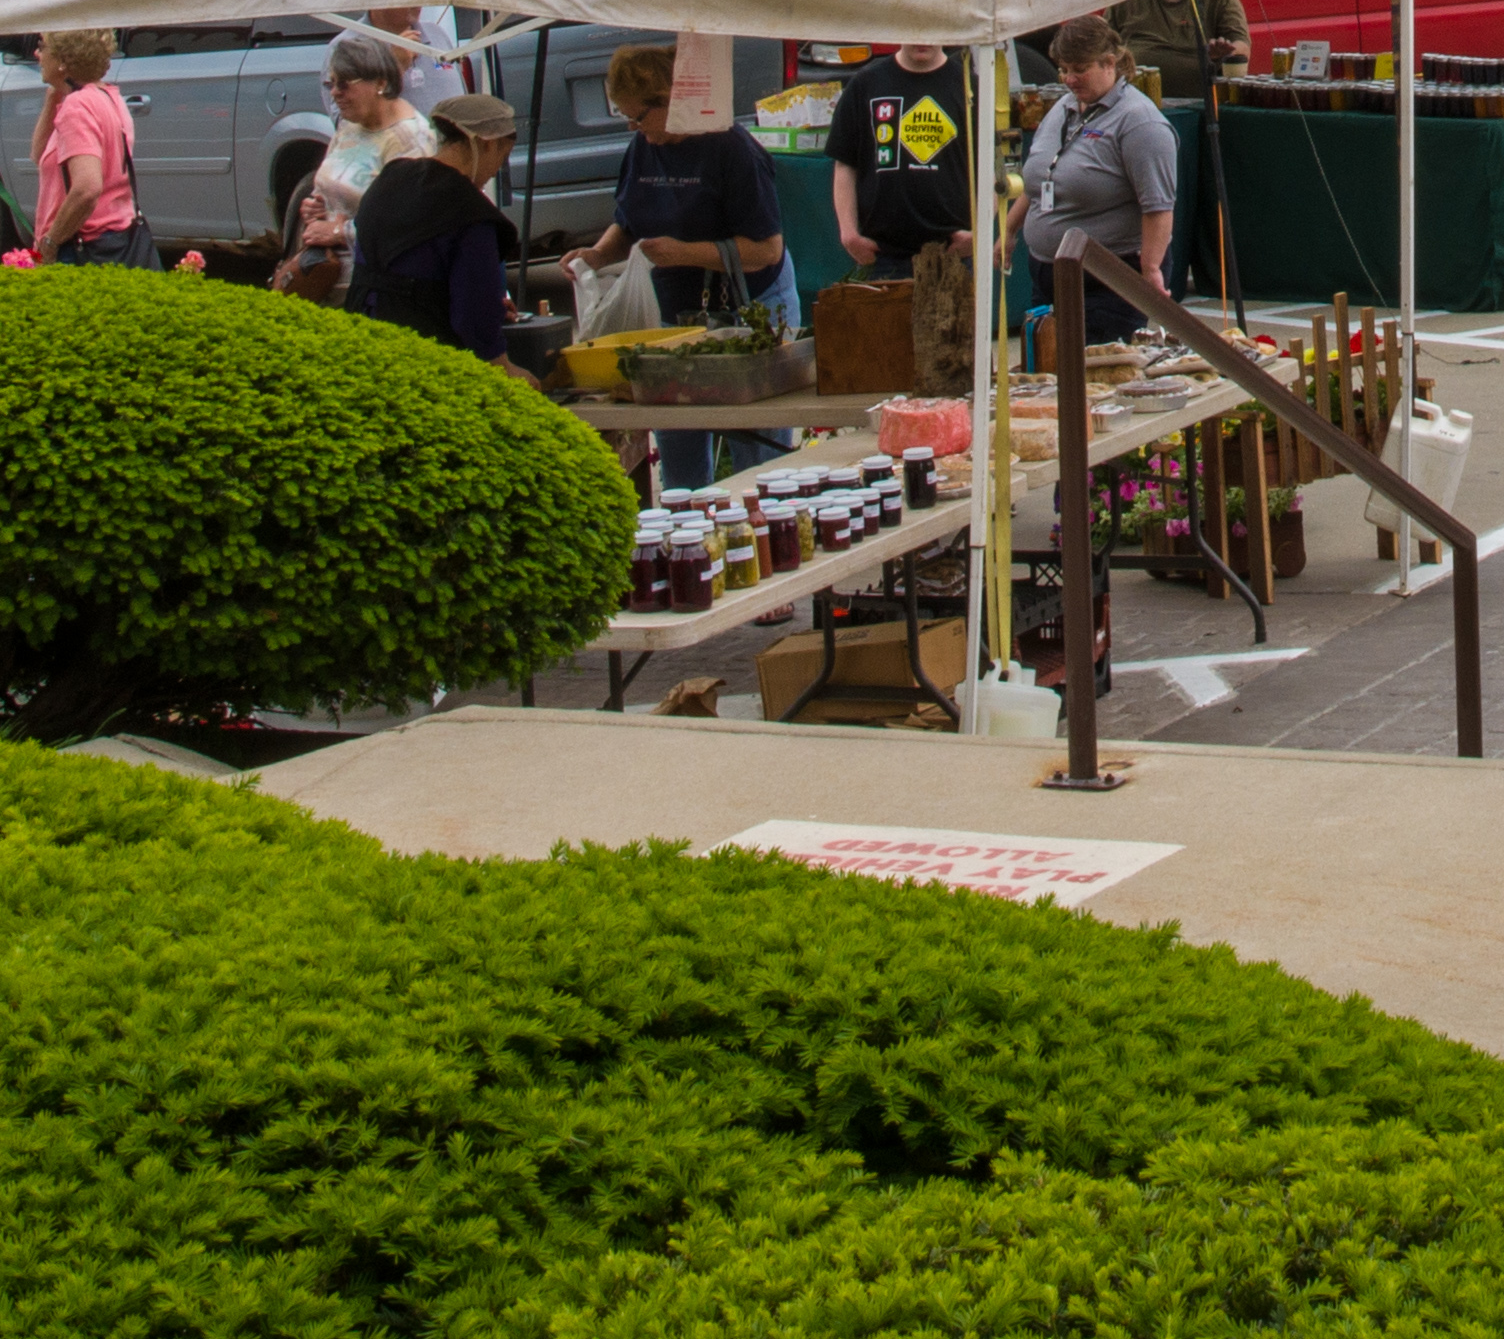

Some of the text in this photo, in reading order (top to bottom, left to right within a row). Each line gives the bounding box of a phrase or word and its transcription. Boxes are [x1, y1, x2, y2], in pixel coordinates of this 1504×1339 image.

[878, 104, 892, 118] M
[913, 112, 942, 123] HILL
[880, 125, 887, 140] J
[904, 124, 944, 134] DRIVING
[905, 134, 942, 144] SCHOOL
[878, 149, 890, 163] M
[821, 838, 1074, 864] ALLOWED
[976, 866, 1110, 885] PLAY
